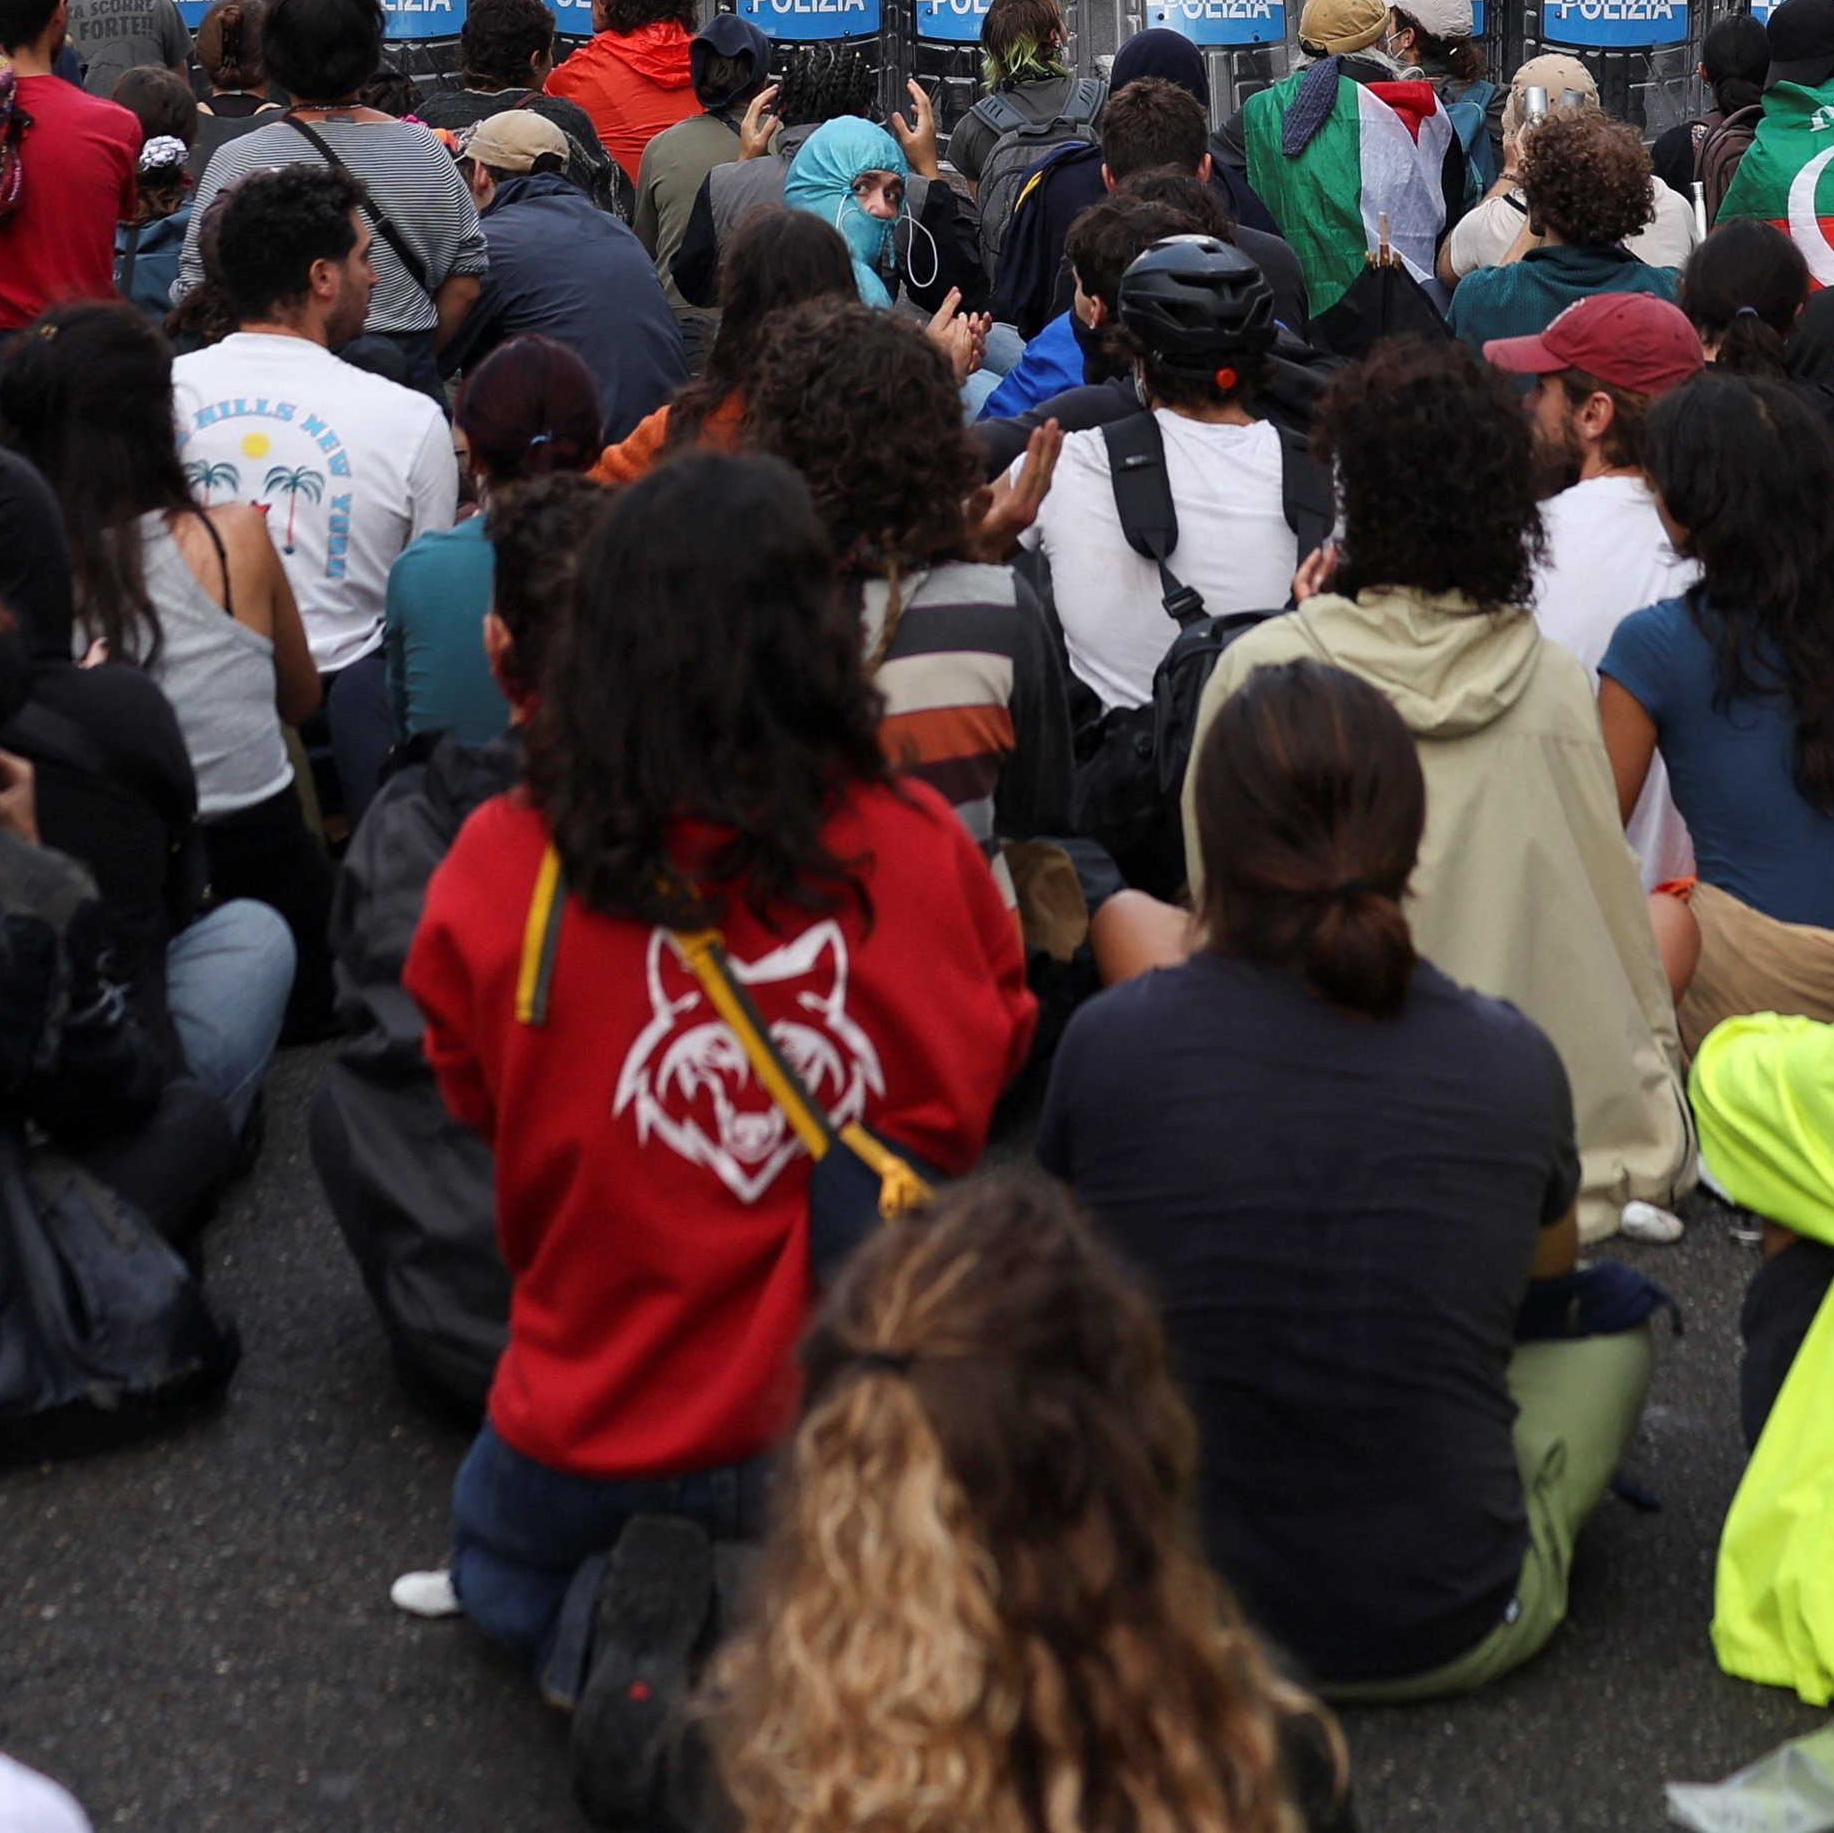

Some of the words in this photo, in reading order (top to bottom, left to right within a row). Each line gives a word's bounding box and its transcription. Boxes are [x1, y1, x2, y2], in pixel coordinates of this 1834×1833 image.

[80, 16, 154, 41] FORTE!!
[194, 398, 297, 429] HILLS
[300, 413, 352, 478] NEW
[325, 493, 353, 578] YORK
